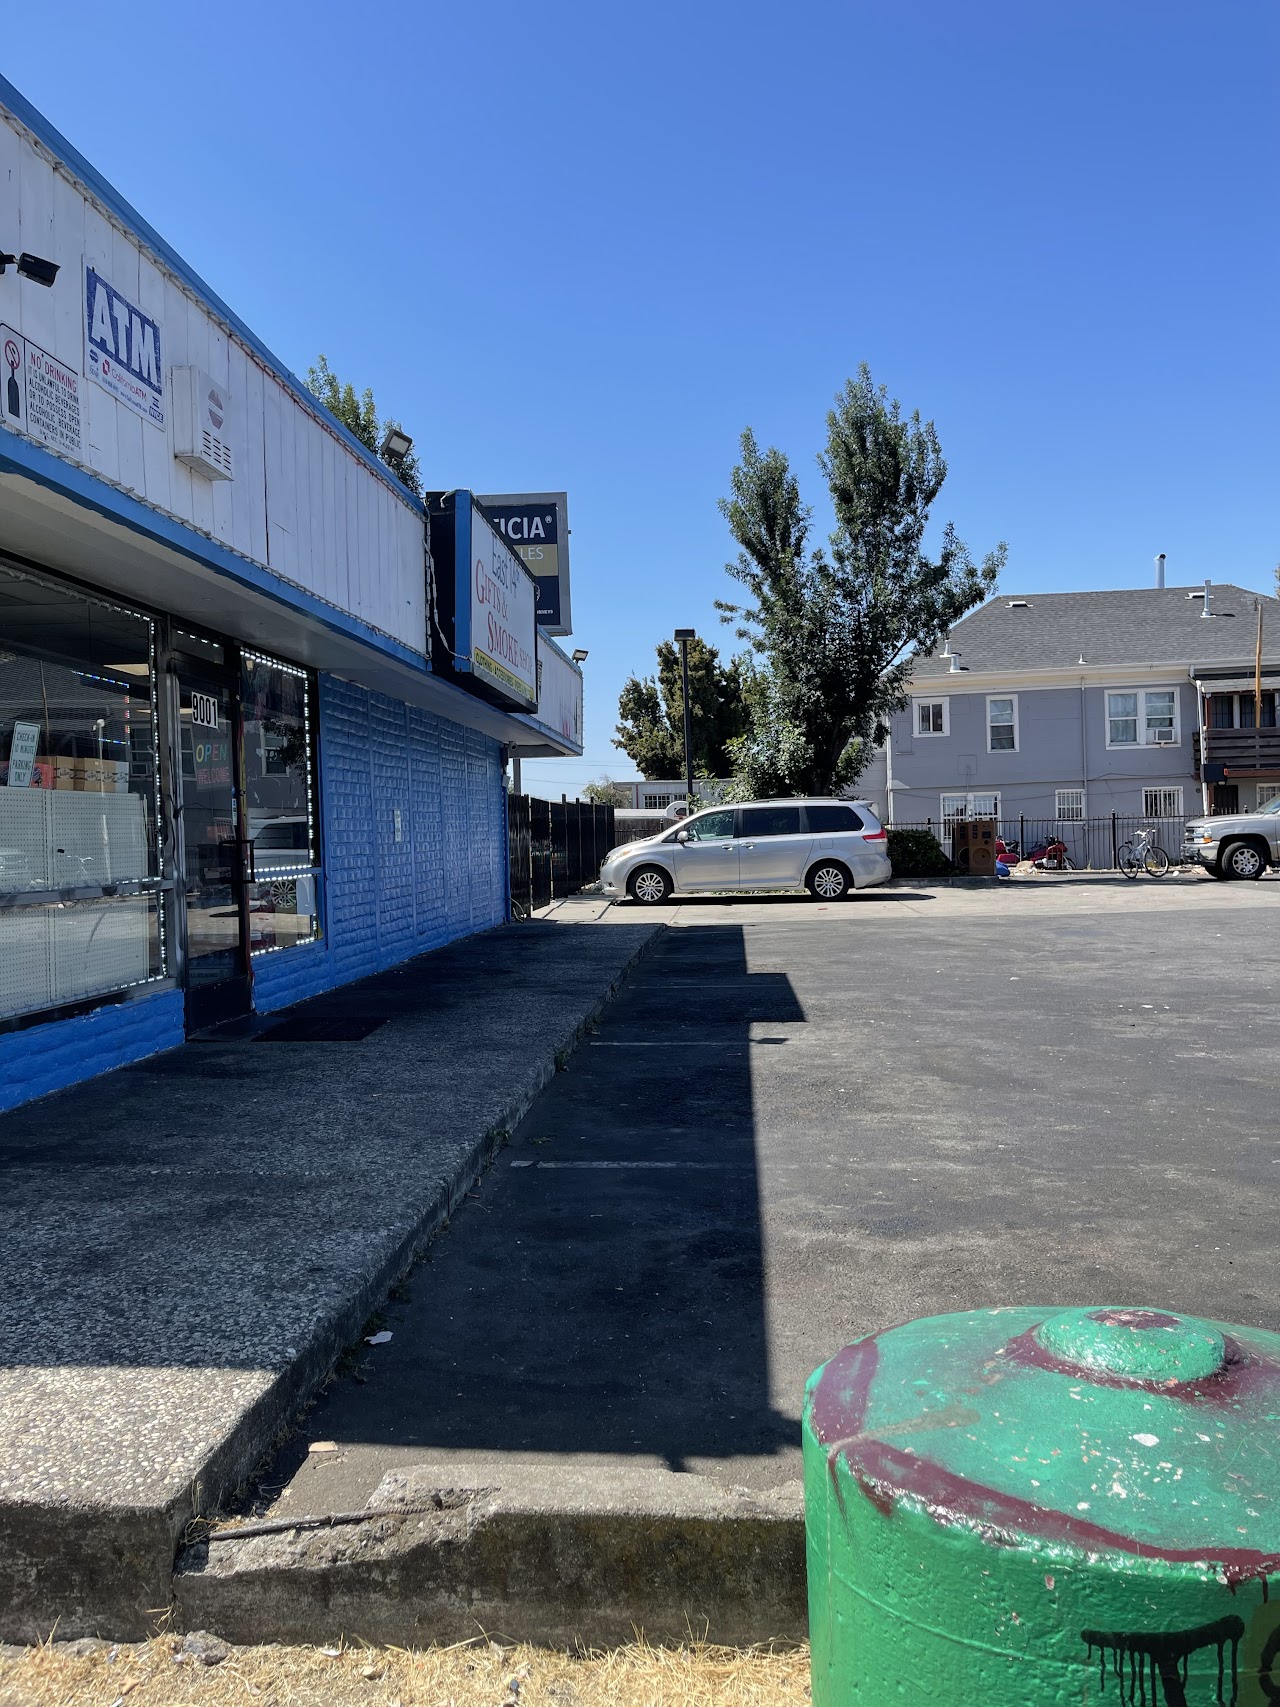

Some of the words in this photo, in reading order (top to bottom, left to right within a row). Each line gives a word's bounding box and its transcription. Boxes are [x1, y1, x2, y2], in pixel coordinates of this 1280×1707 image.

[91, 282, 158, 386] ATM
[31, 352, 41, 369] NO
[45, 361, 77, 393] DRINKING
[39, 371, 60, 394] UNLAWFUL
[61, 387, 67, 398] TO
[67, 391, 79, 406] DRINK
[29, 377, 54, 400] ALCOHOLIC
[55, 394, 80, 417] BEVERAGES
[29, 388, 36, 399] OR
[38, 394, 44, 406] TO
[46, 399, 67, 420] POSSESS
[68, 413, 80, 428] OPEN
[30, 401, 55, 424] ALCOHOLIC
[58, 417, 80, 439] BEVERAGE
[30, 412, 58, 436] CONTAINERS
[65, 433, 81, 450] PUBLIC
[492, 532, 508, 589] East
[476, 559, 501, 614] GIFTS
[487, 611, 519, 668] SMOKE
[519, 648, 533, 675] SHOP
[192, 693, 217, 727] 9001
[14, 743, 20, 754] 10
[20, 744, 35, 755] MINUTE
[17, 732, 36, 742] CHECK-IN
[196, 743, 227, 762] OPEN
[12, 759, 32, 771] PARKING
[14, 771, 26, 783] ONLY
[197, 766, 230, 785] WELCOME
